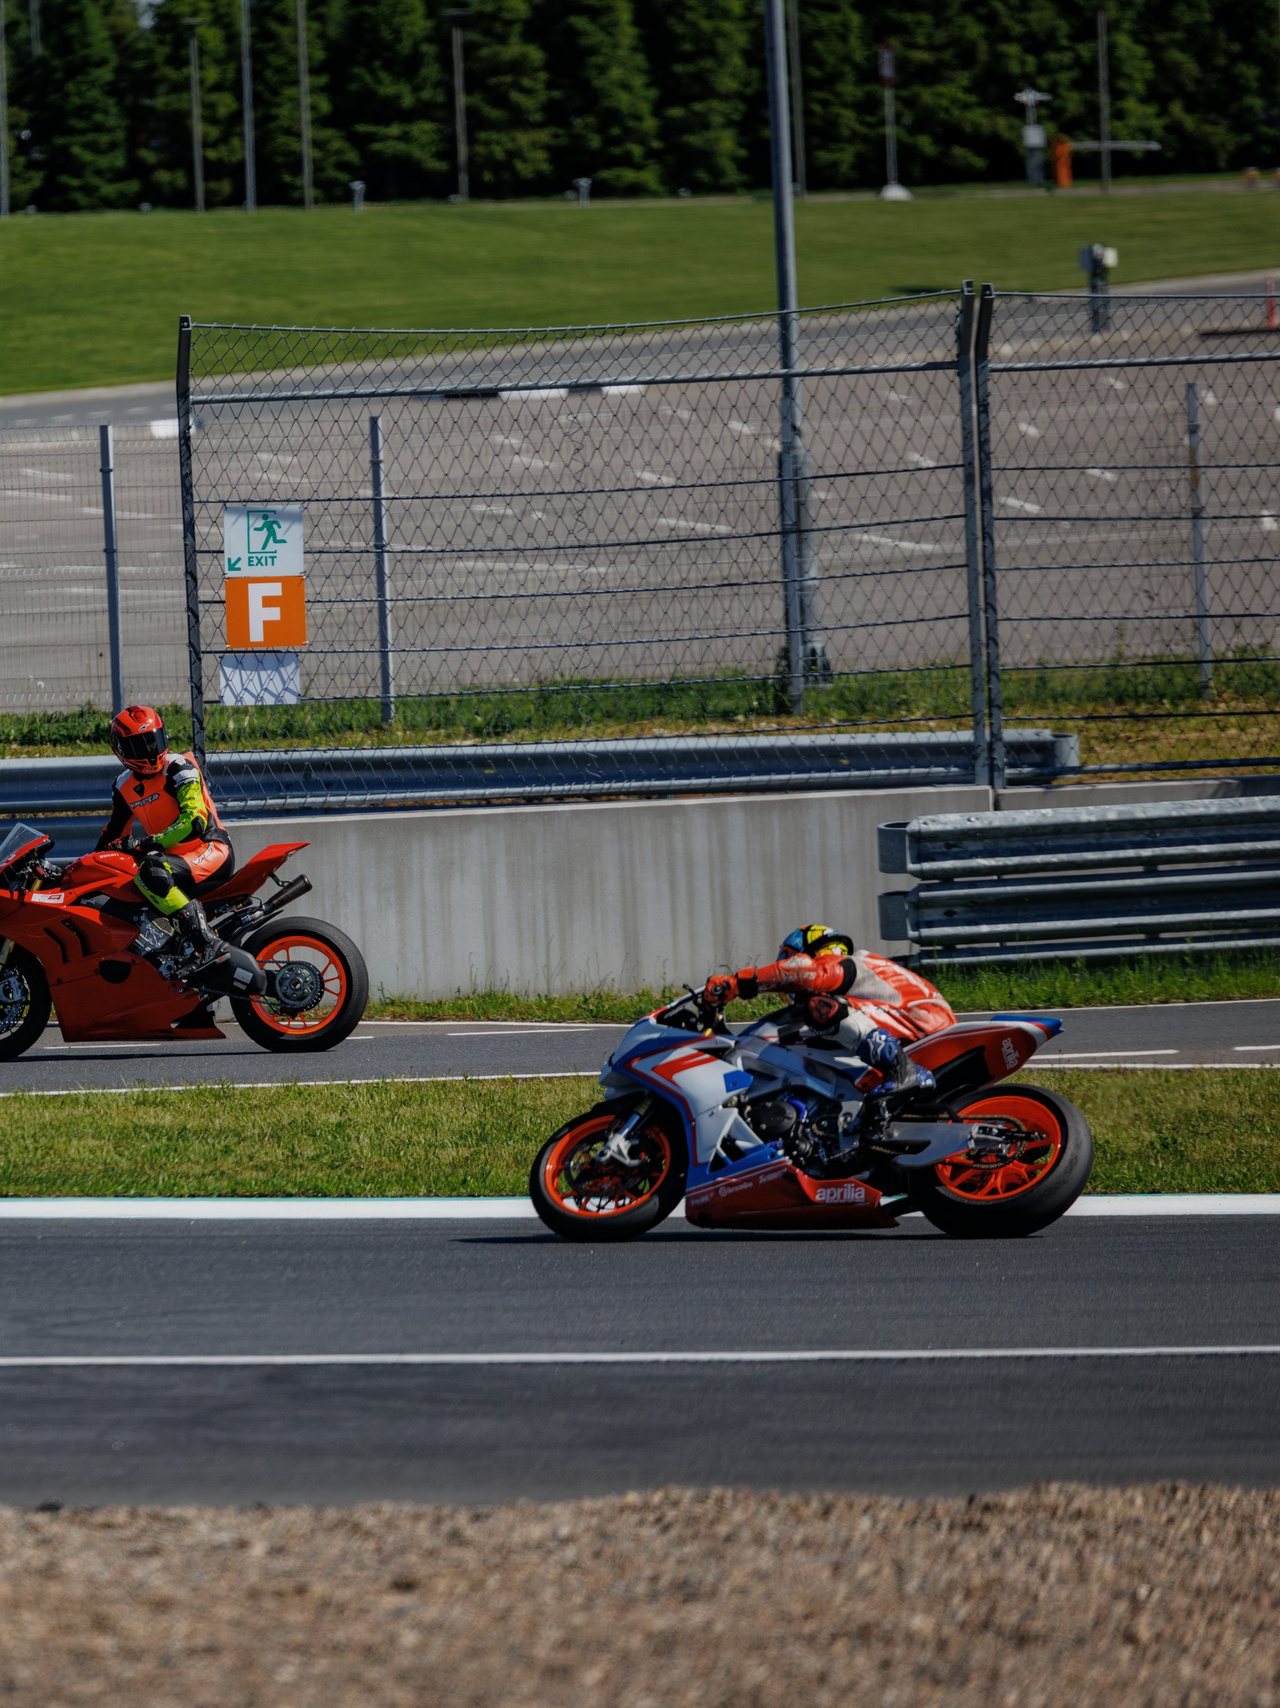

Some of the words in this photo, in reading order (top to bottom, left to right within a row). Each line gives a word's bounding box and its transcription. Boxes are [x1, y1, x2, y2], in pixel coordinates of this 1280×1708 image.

[247, 555, 277, 567] EXIT
[248, 582, 283, 643] F
[1002, 1037, 1020, 1070] aprilia
[814, 1183, 866, 1203] aprilia
